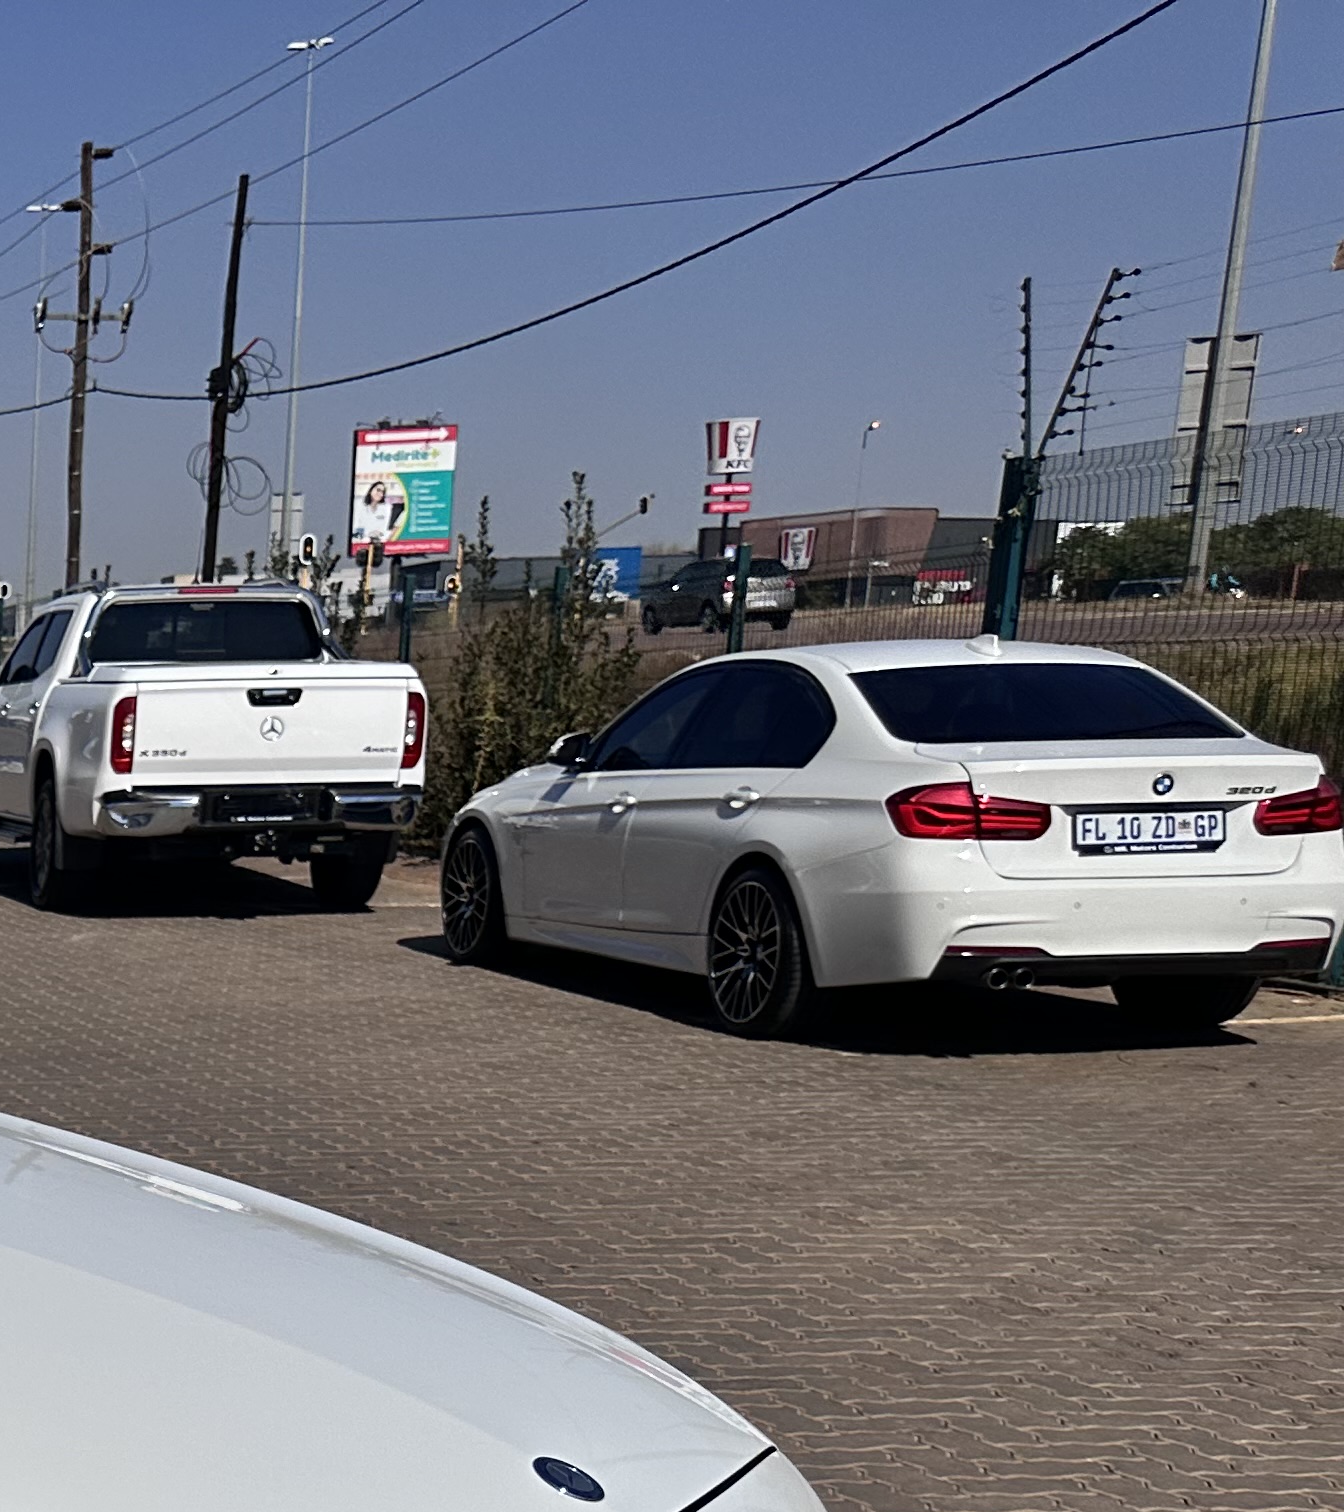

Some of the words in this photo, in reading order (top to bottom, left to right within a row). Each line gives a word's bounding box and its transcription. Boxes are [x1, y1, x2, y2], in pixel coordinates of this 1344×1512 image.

[724, 459, 752, 469] KFC
[1226, 786, 1277, 795] 320d
[1081, 817, 1107, 842] FL
[1116, 816, 1142, 841] 10
[1151, 815, 1176, 840] ZD
[1194, 814, 1218, 838] GP
